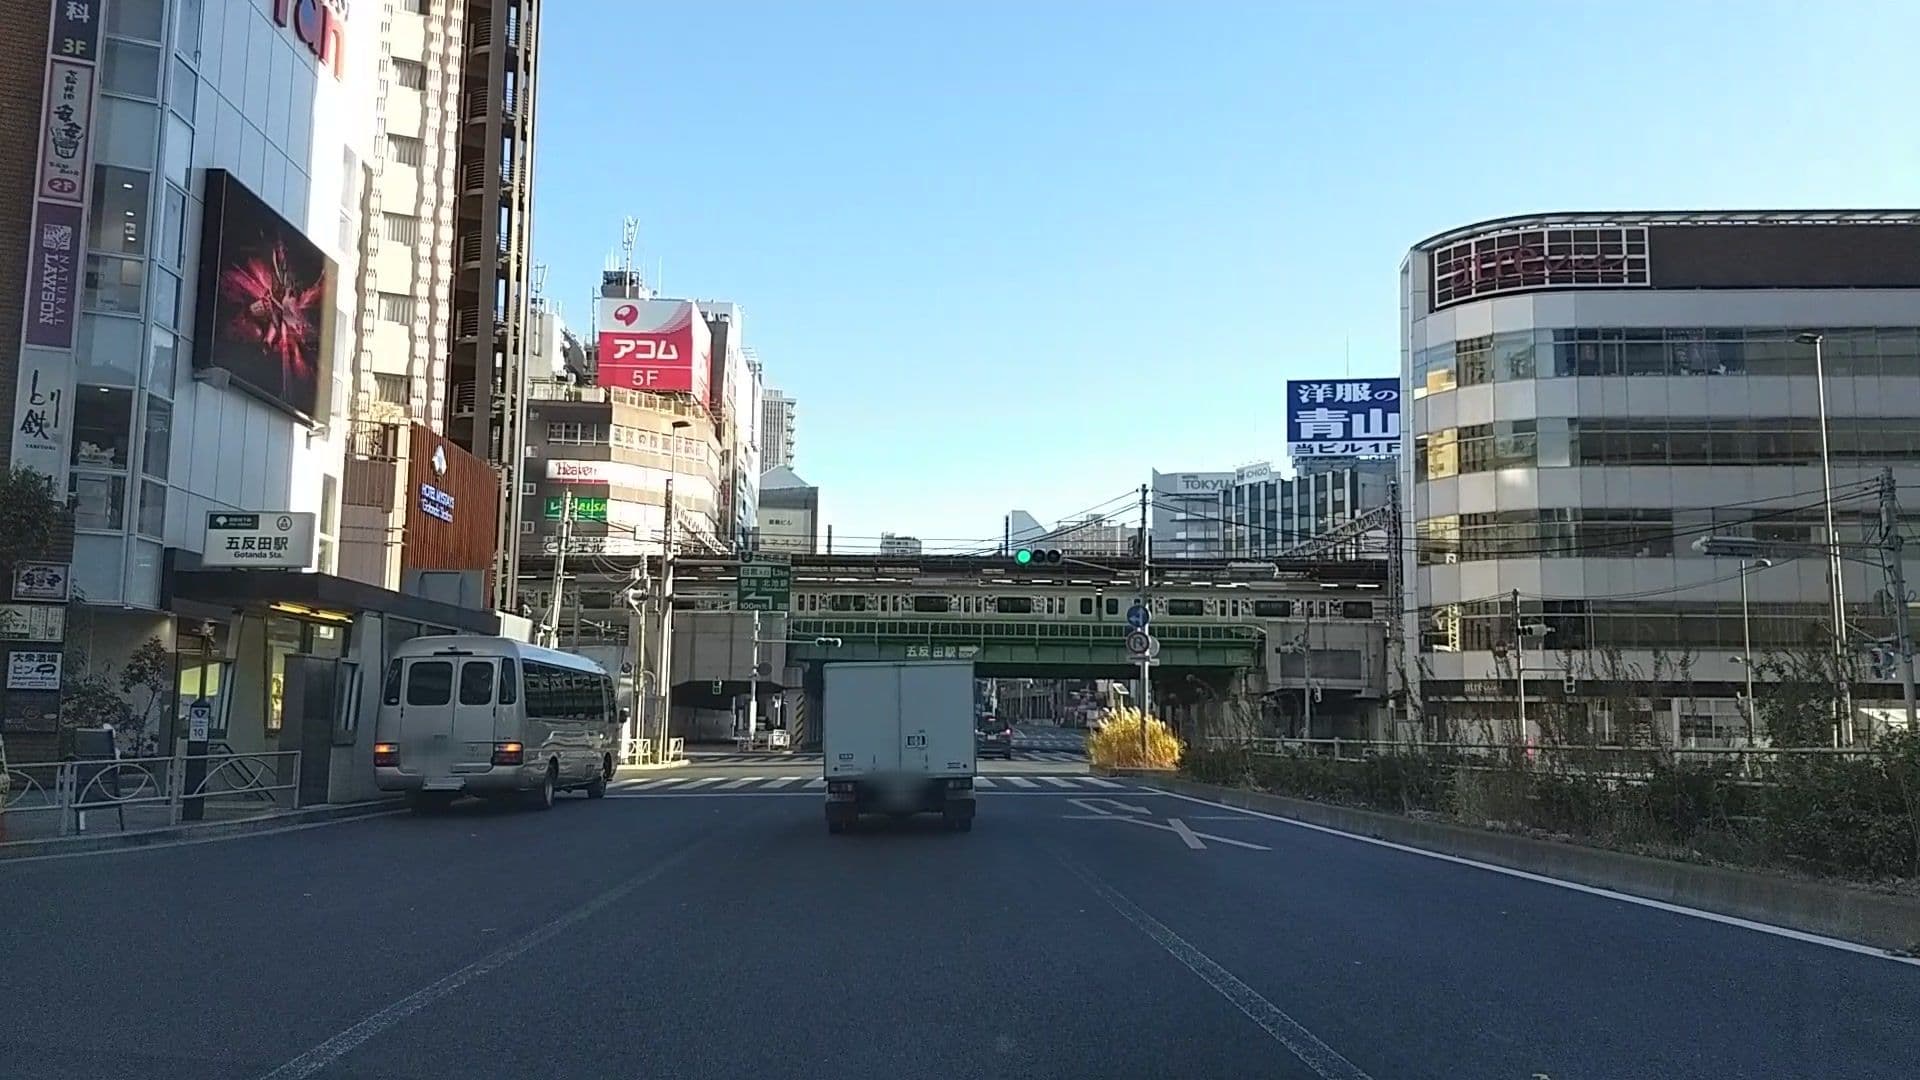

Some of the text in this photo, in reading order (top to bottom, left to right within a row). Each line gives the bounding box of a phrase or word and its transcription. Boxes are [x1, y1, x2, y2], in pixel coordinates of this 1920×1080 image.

[66, 1, 90, 23] 科
[62, 38, 87, 55] 3F
[52, 180, 74, 190] 2F
[39, 252, 58, 325] LAWSON
[54, 255, 70, 326] NATURAL
[613, 338, 679, 360] アコム
[632, 370, 660, 386] 5F
[1298, 382, 1399, 404] 洋服の
[20, 369, 61, 440] とり鉄
[1294, 407, 1400, 439] 青山
[1295, 442, 1400, 455] 当ビル1F
[225, 536, 289, 551] 五反田駅
[233, 551, 267, 559] Gotanda
[906, 645, 956, 658] 五反田駅
[193, 728, 204, 737] 10
